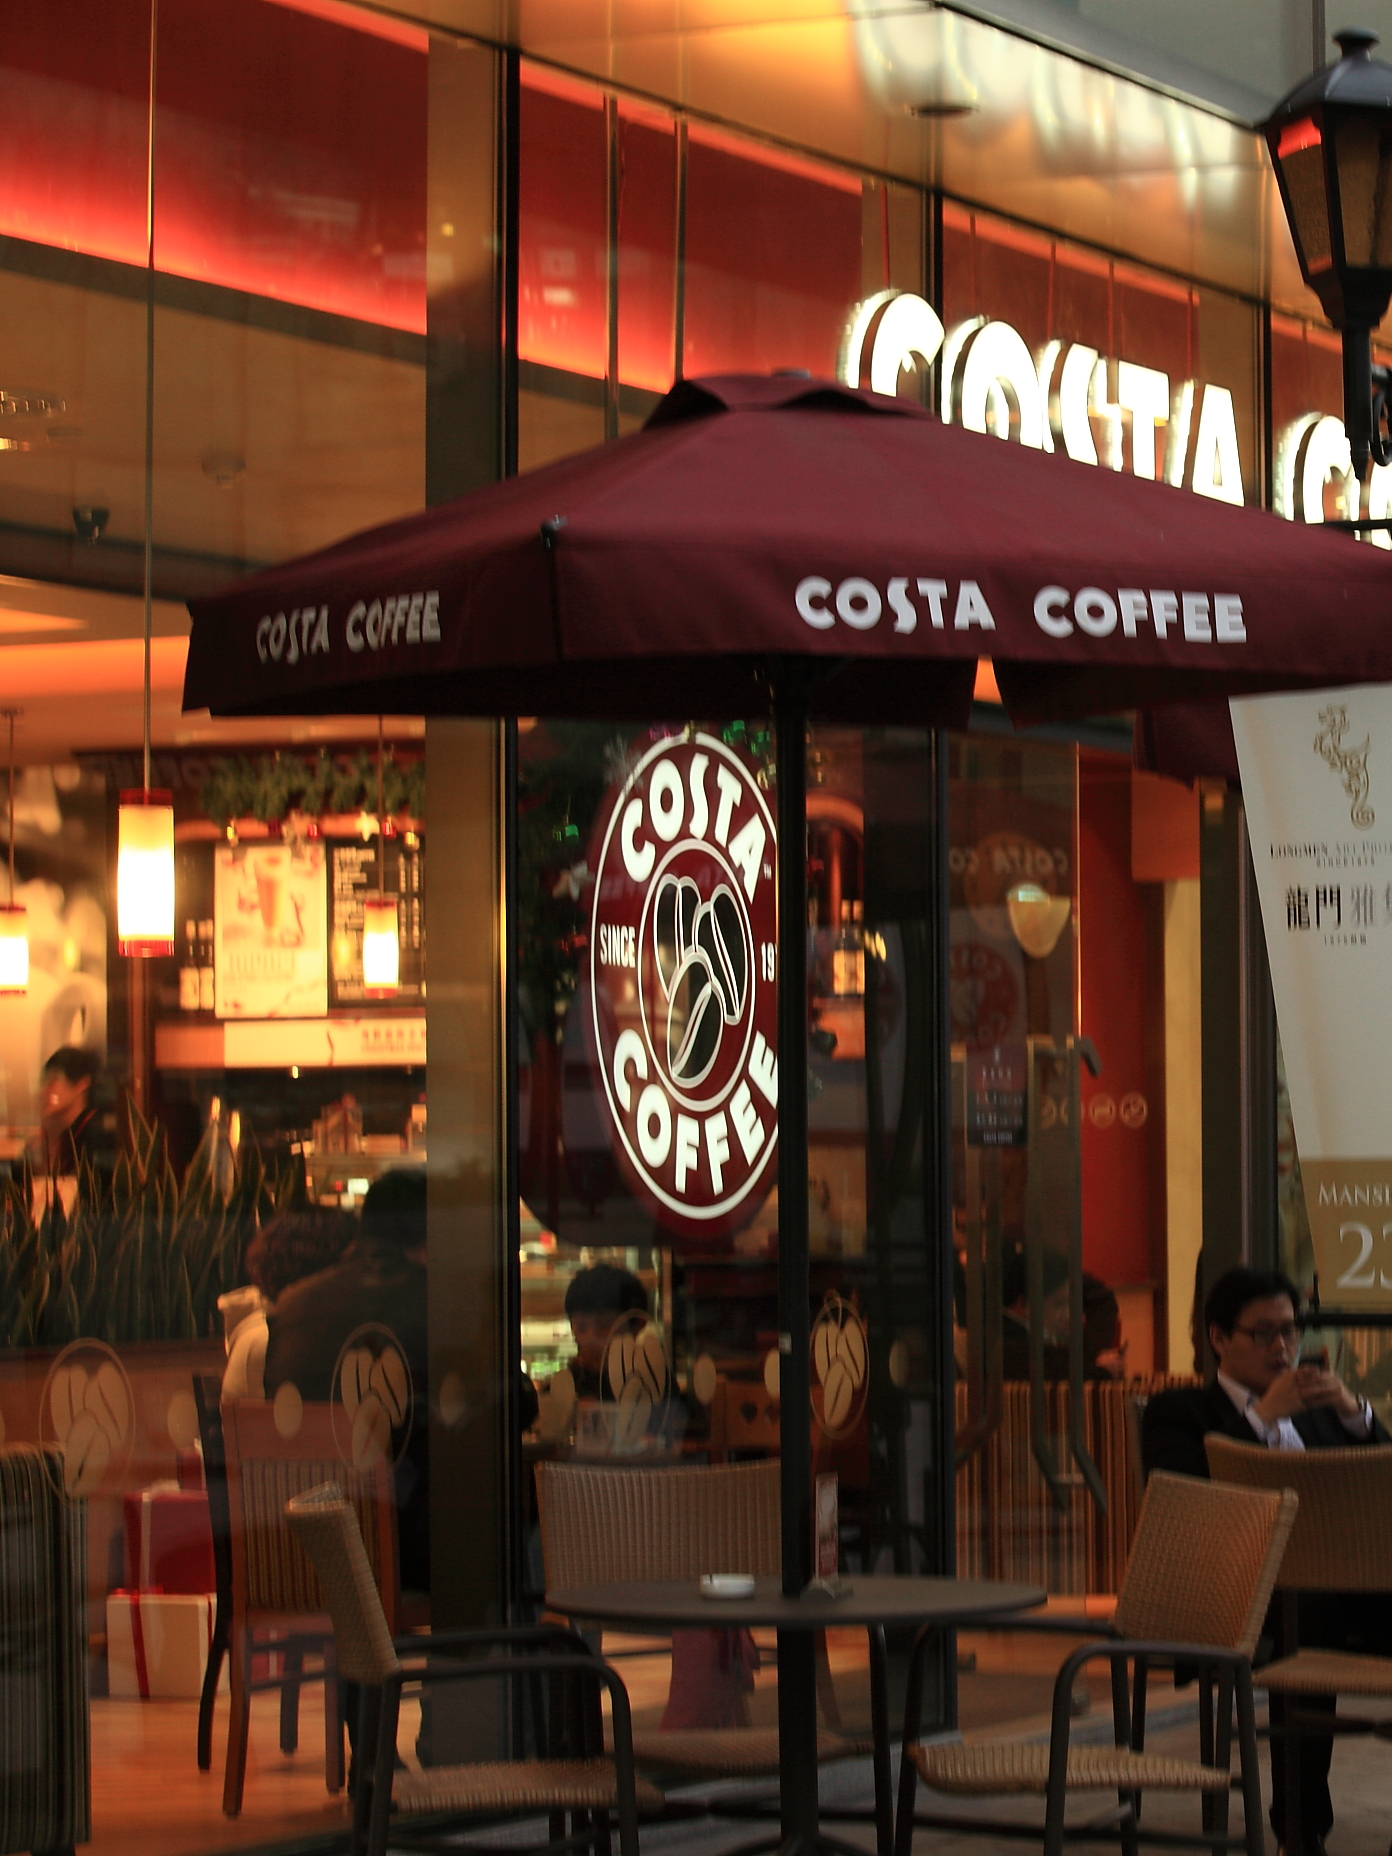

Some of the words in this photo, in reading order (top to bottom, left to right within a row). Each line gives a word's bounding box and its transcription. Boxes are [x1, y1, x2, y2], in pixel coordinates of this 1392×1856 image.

[256, 604, 330, 665] COSTA
[346, 590, 442, 653] COFFEE
[795, 576, 995, 635] COSTA
[1033, 585, 1247, 643] COFFEE
[621, 752, 766, 904] COSTA
[600, 923, 635, 969] SINCE
[761, 941, 778, 982] 19
[614, 1029, 778, 1195] COFFEE
